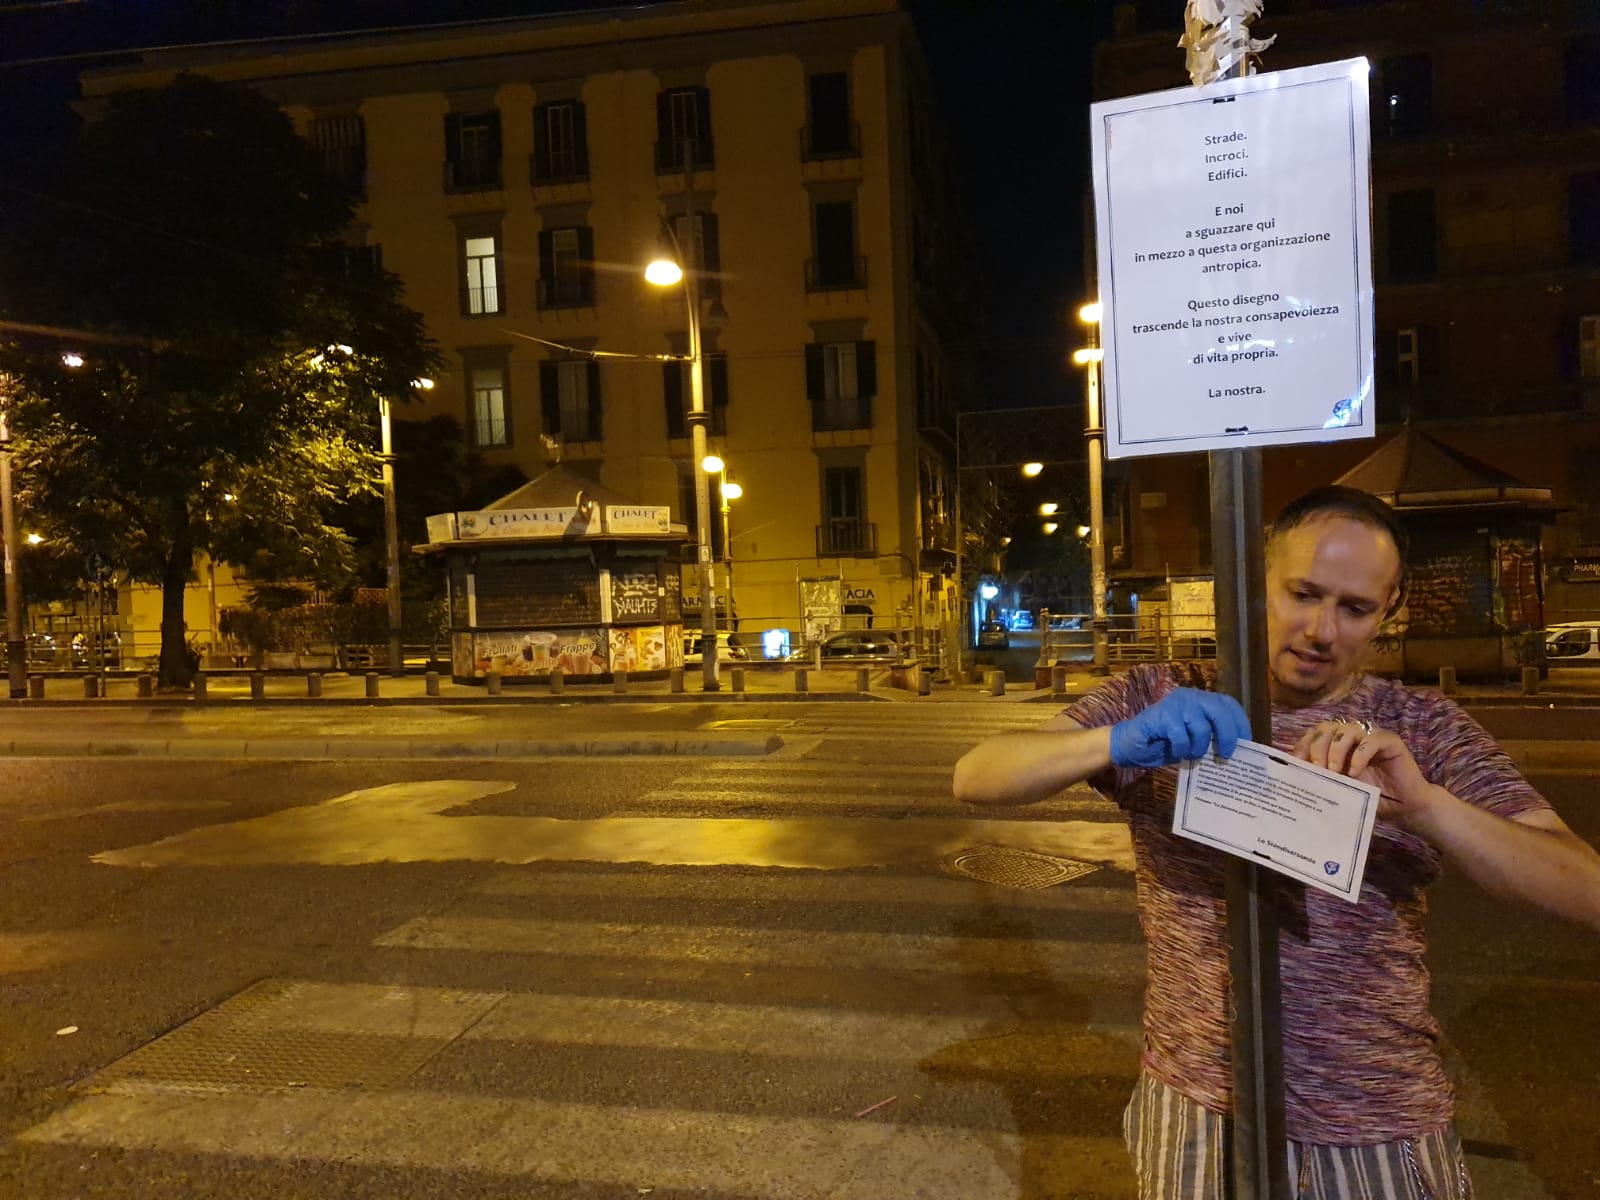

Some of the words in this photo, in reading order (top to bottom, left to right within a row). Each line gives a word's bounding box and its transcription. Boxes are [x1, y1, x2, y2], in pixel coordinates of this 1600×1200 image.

[1204, 131, 1248, 146] Strade.
[1204, 149, 1249, 164] Incroci.
[1207, 167, 1248, 182] Edifici.
[1215, 206, 1222, 216] E
[1225, 203, 1244, 215] noi
[1185, 229, 1192, 239] a
[1195, 222, 1254, 240] sguazzare
[1256, 218, 1276, 234] qui
[1134, 252, 1146, 264] in
[1148, 249, 1185, 262] mezzo
[1188, 248, 1195, 257] a
[1197, 242, 1238, 258] questa
[1240, 231, 1331, 252] organizzazione
[1201, 260, 1262, 275] antropica.
[1187, 297, 1230, 312] Questo
[1232, 292, 1280, 307] disegno
[1132, 318, 1189, 334] trascende
[1191, 316, 1202, 328] la
[1204, 313, 1243, 327] nostra
[1217, 335, 1225, 344] e
[1227, 332, 1252, 343] vive
[1193, 353, 1204, 365] di
[1207, 351, 1229, 364] vita
[1231, 347, 1279, 364] propria.
[1208, 388, 1222, 398] La
[1224, 384, 1266, 398] nostra.
[1573, 562, 1600, 573] PHARM
[1257, 836, 1266, 845] Lo
